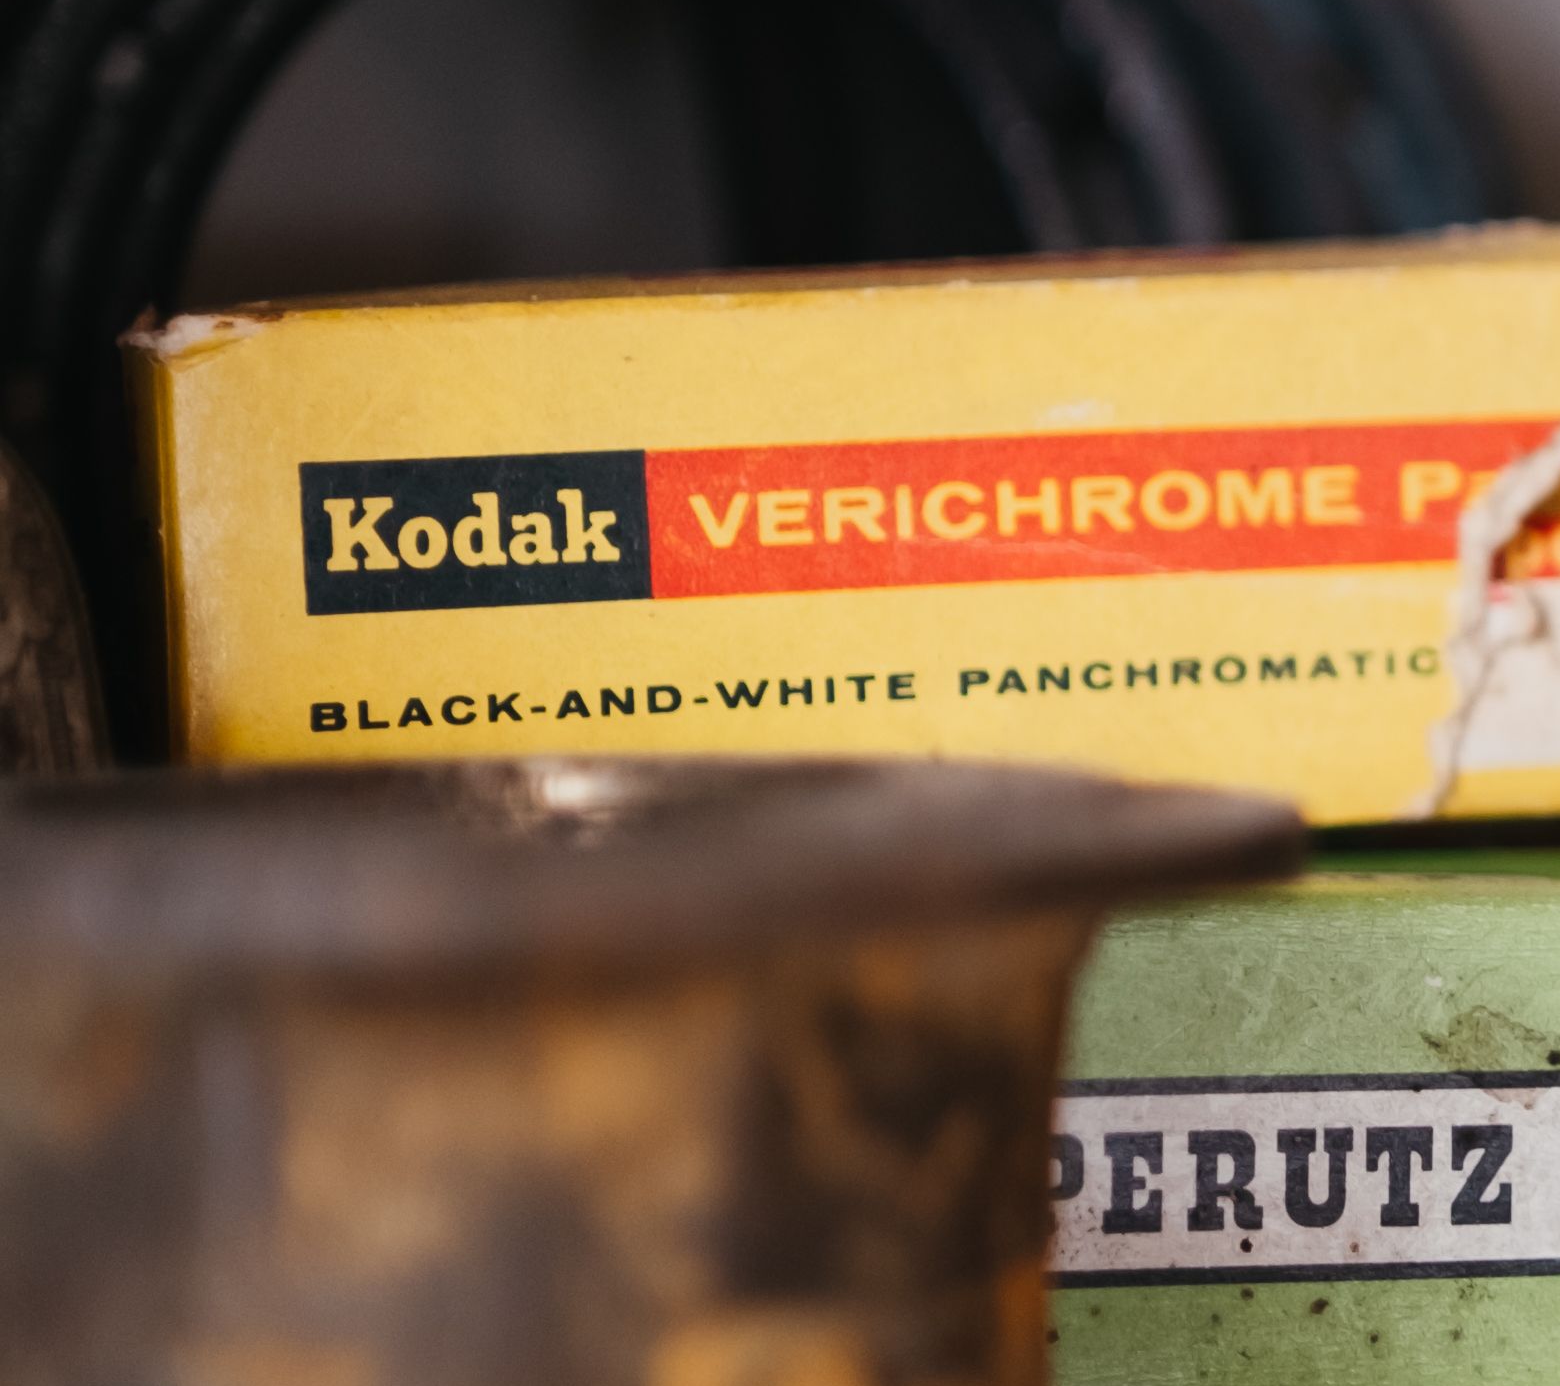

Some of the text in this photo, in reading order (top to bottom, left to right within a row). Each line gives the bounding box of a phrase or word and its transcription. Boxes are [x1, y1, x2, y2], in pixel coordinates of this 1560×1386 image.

[322, 487, 621, 573] Kodak
[688, 464, 1364, 548] VERICHROME
[309, 646, 1442, 733] BLACK-AND-WHITE PANCHROMATIC
